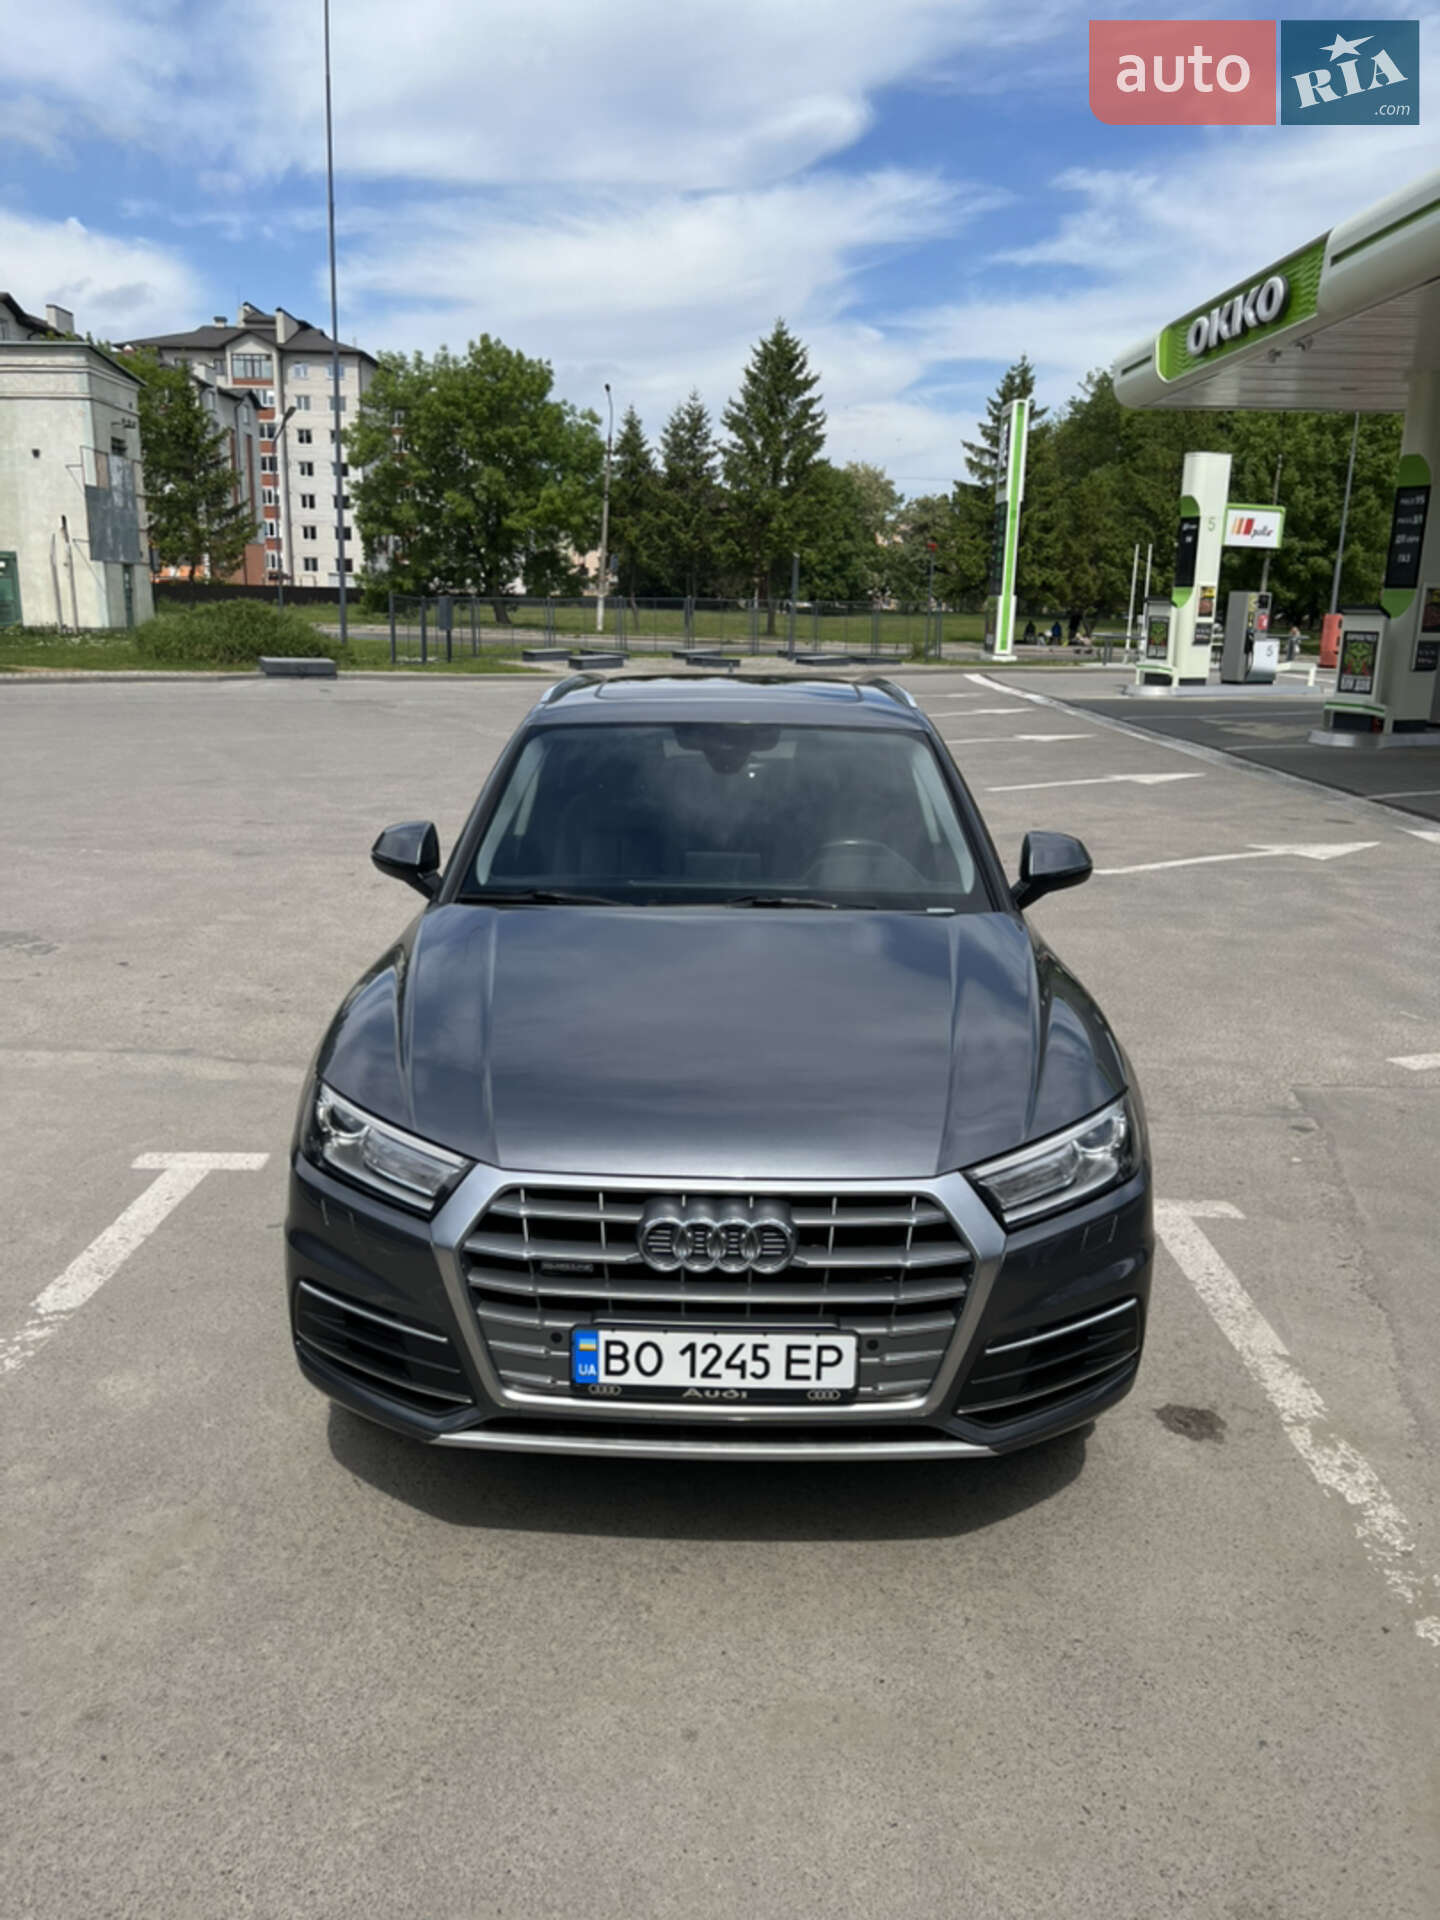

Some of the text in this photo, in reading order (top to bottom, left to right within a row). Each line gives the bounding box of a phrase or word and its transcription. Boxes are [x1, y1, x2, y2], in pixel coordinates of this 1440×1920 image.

[1186, 273, 1289, 356] OKKO
[1207, 516, 1216, 533] 5
[604, 1340, 844, 1381] BO 1245 EP
[578, 1363, 598, 1376] UA
[682, 1386, 748, 1399] Audi
